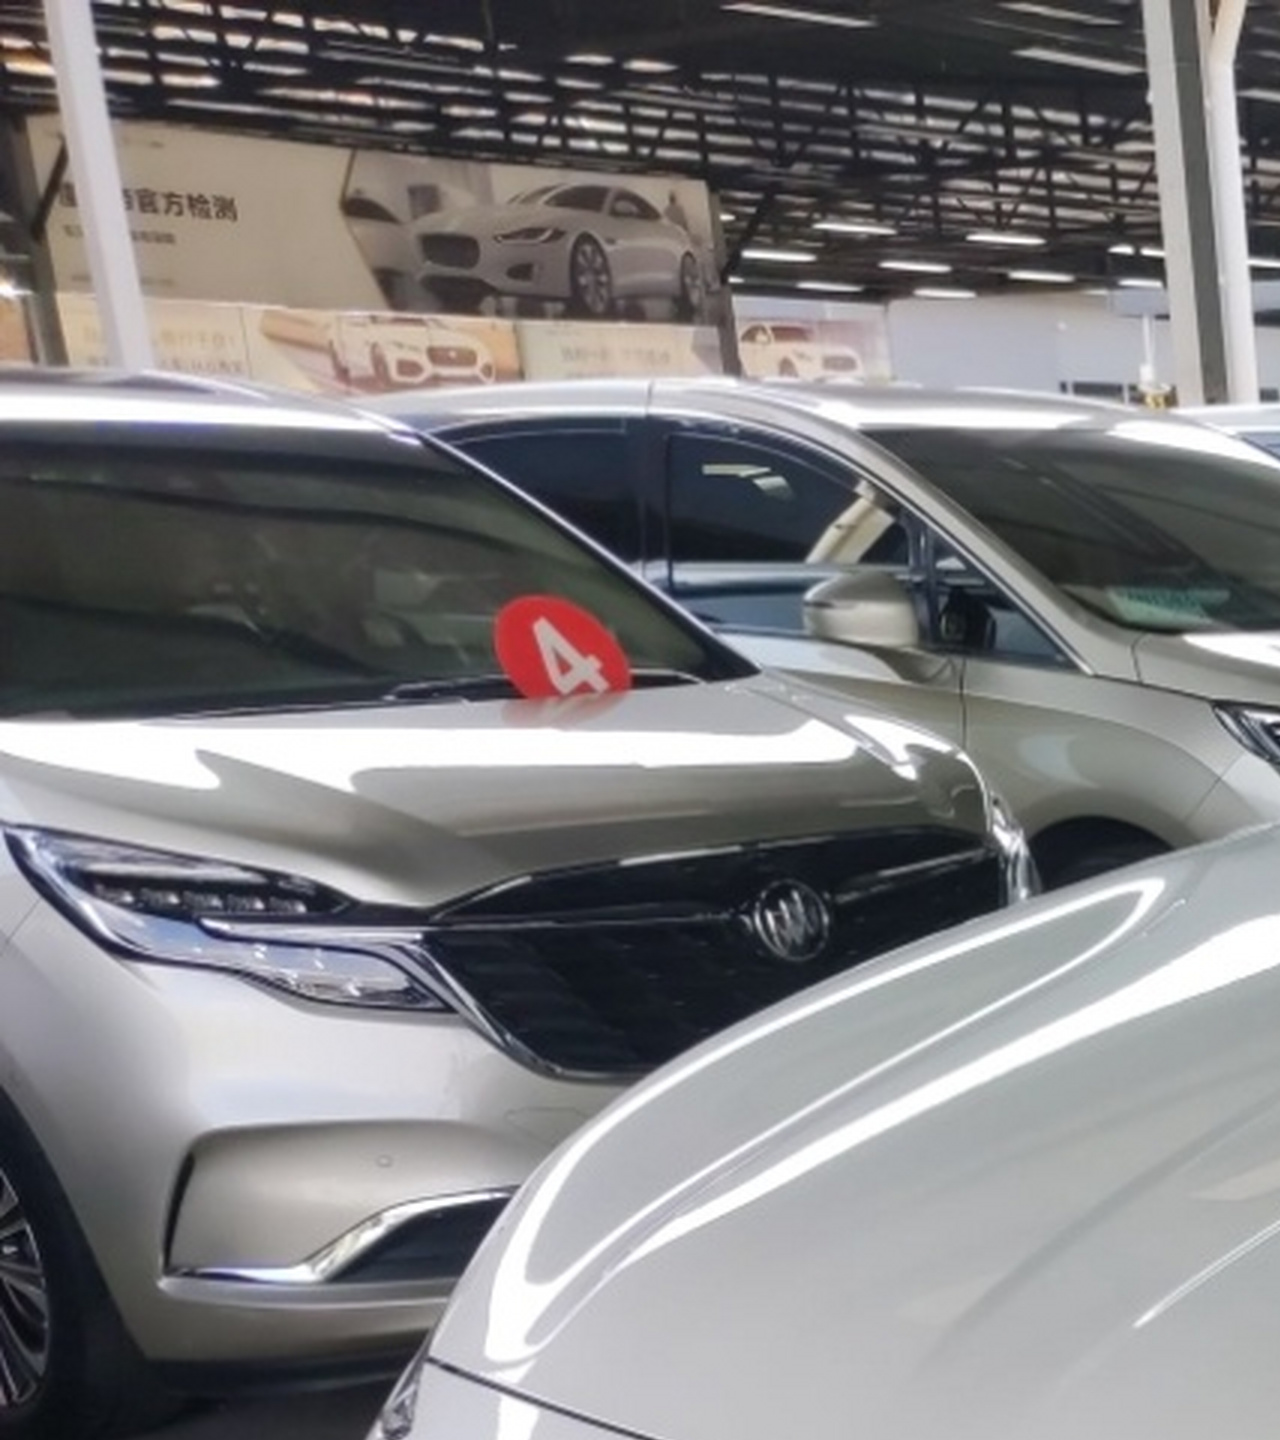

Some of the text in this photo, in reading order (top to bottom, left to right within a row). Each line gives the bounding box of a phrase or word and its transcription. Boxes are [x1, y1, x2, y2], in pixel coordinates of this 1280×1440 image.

[61, 183, 238, 222] 官方检测
[533, 616, 610, 695] 4
